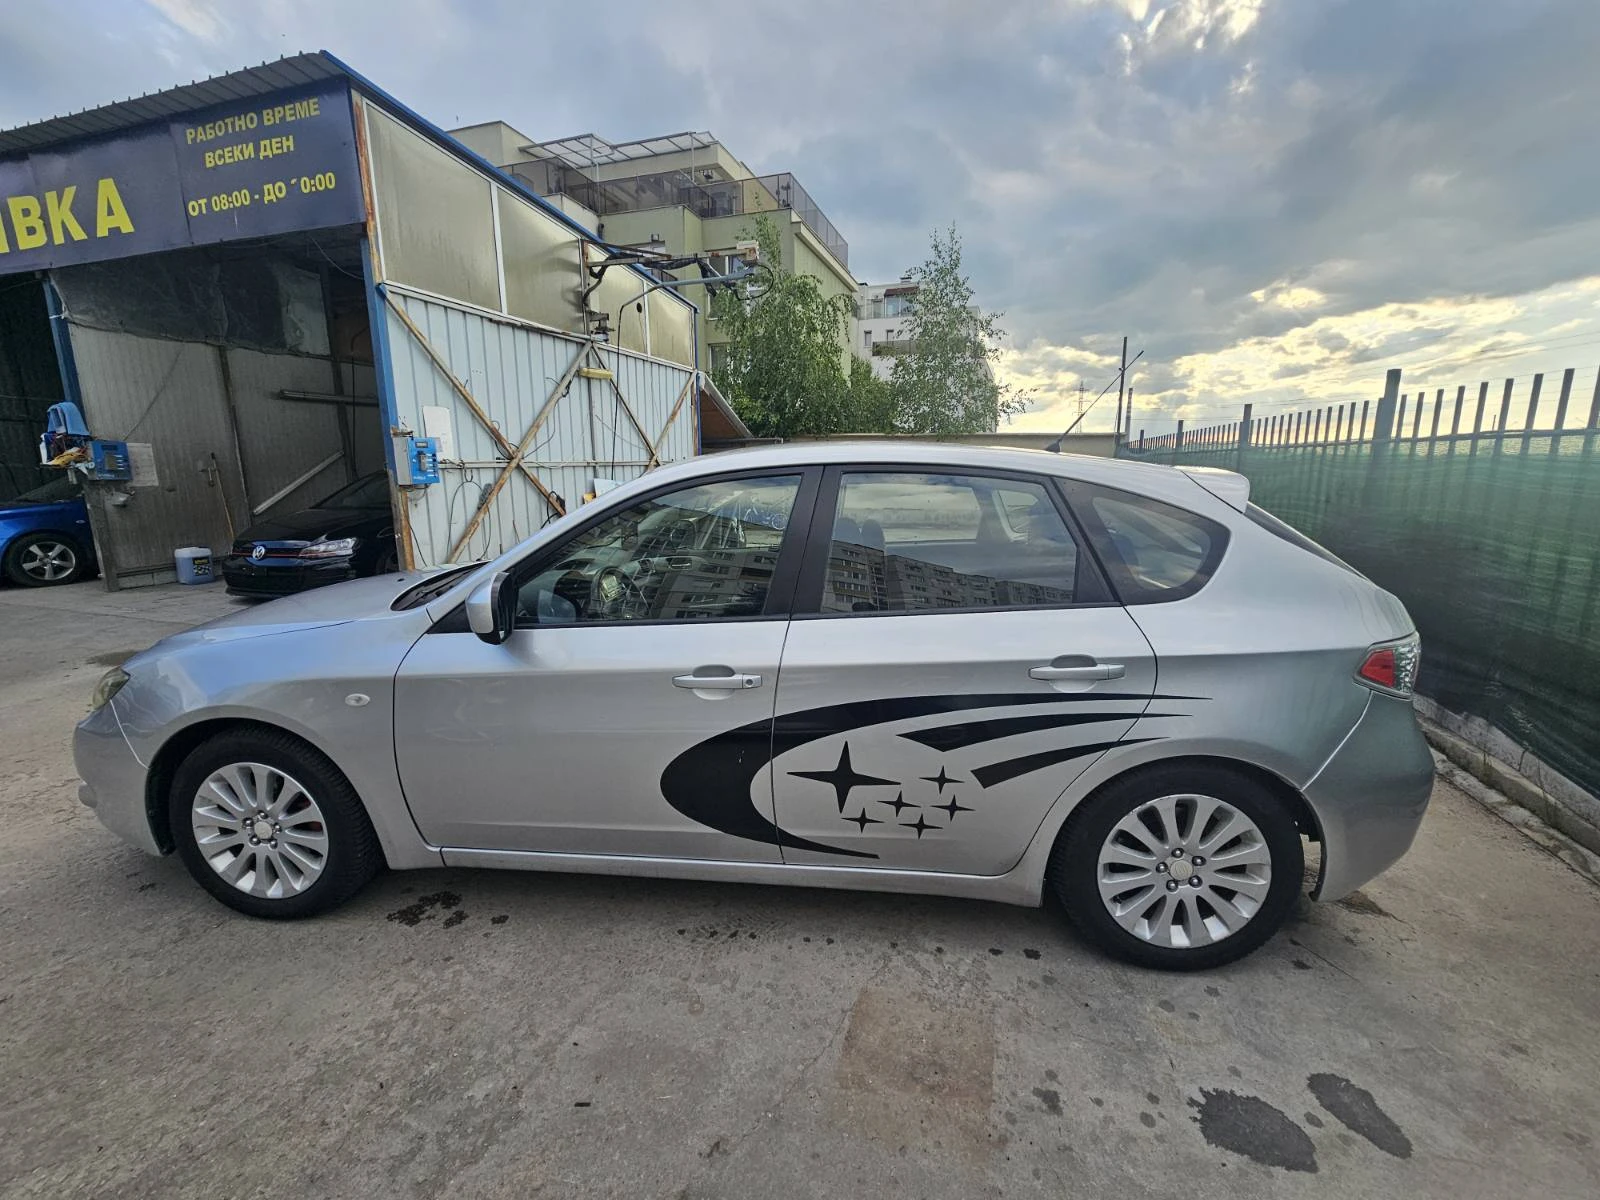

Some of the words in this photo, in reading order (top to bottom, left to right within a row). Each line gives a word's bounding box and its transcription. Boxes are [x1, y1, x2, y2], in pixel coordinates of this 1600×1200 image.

[186, 112, 258, 144] РАБОТНО
[262, 98, 321, 126] ВРЕМЕ
[204, 142, 255, 168] ВСЕКИ
[259, 135, 295, 160] ДЕН
[188, 198, 207, 217] ОТ
[211, 188, 250, 212] 08:00
[263, 181, 287, 204] ДО
[291, 172, 336, 193] 0:00
